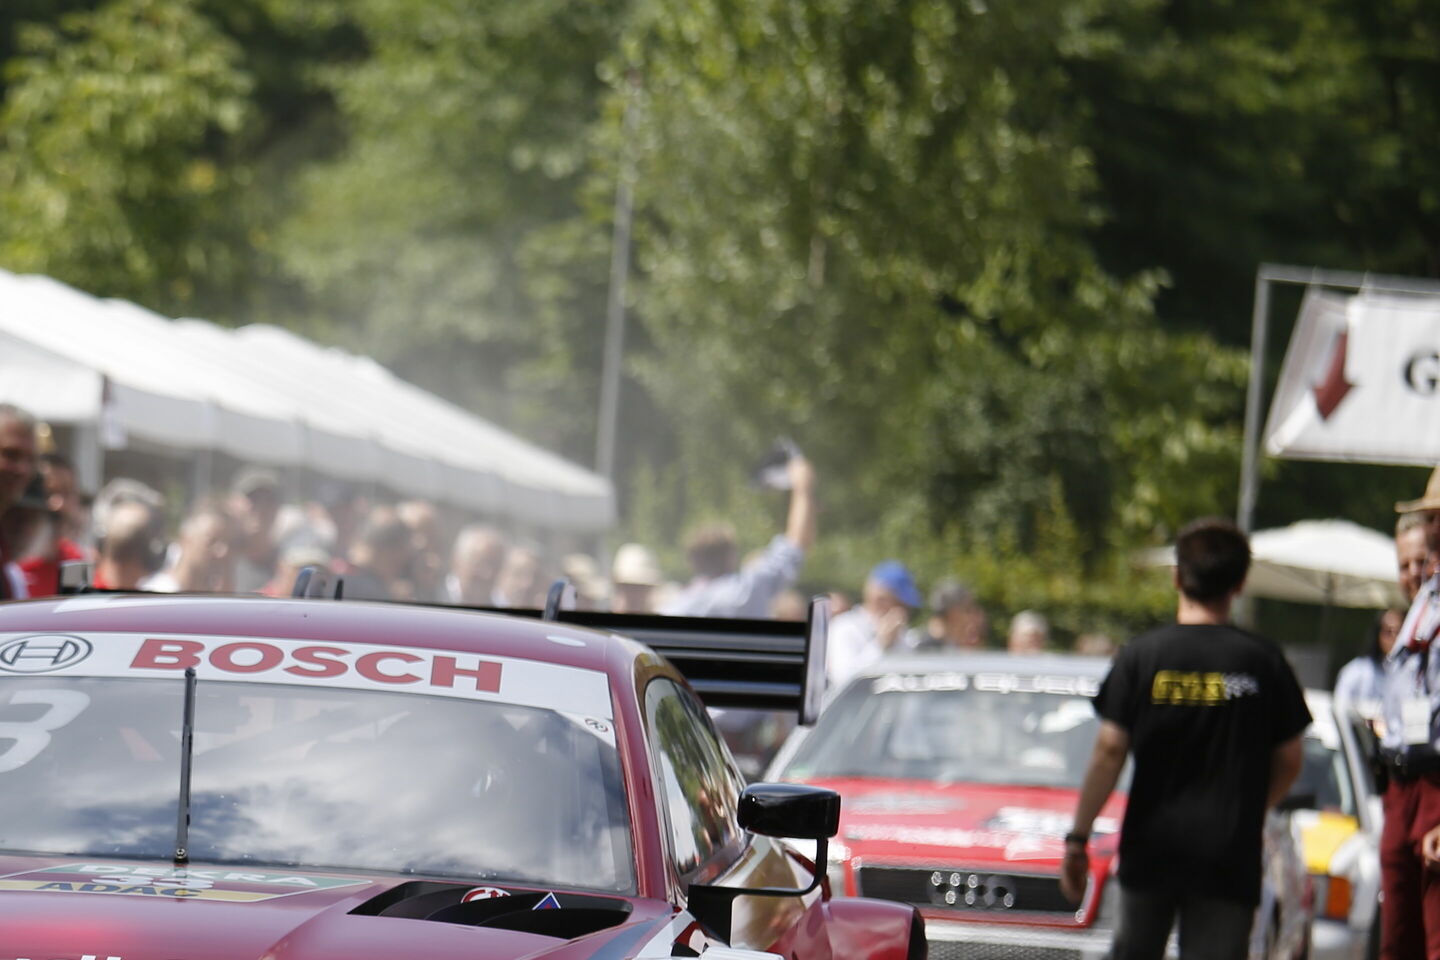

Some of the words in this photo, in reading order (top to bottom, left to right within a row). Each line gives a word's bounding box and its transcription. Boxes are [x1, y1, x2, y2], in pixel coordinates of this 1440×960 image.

[129, 638, 503, 694] BOSCH
[33, 881, 203, 898] ADAC
[91, 874, 215, 889] 33
